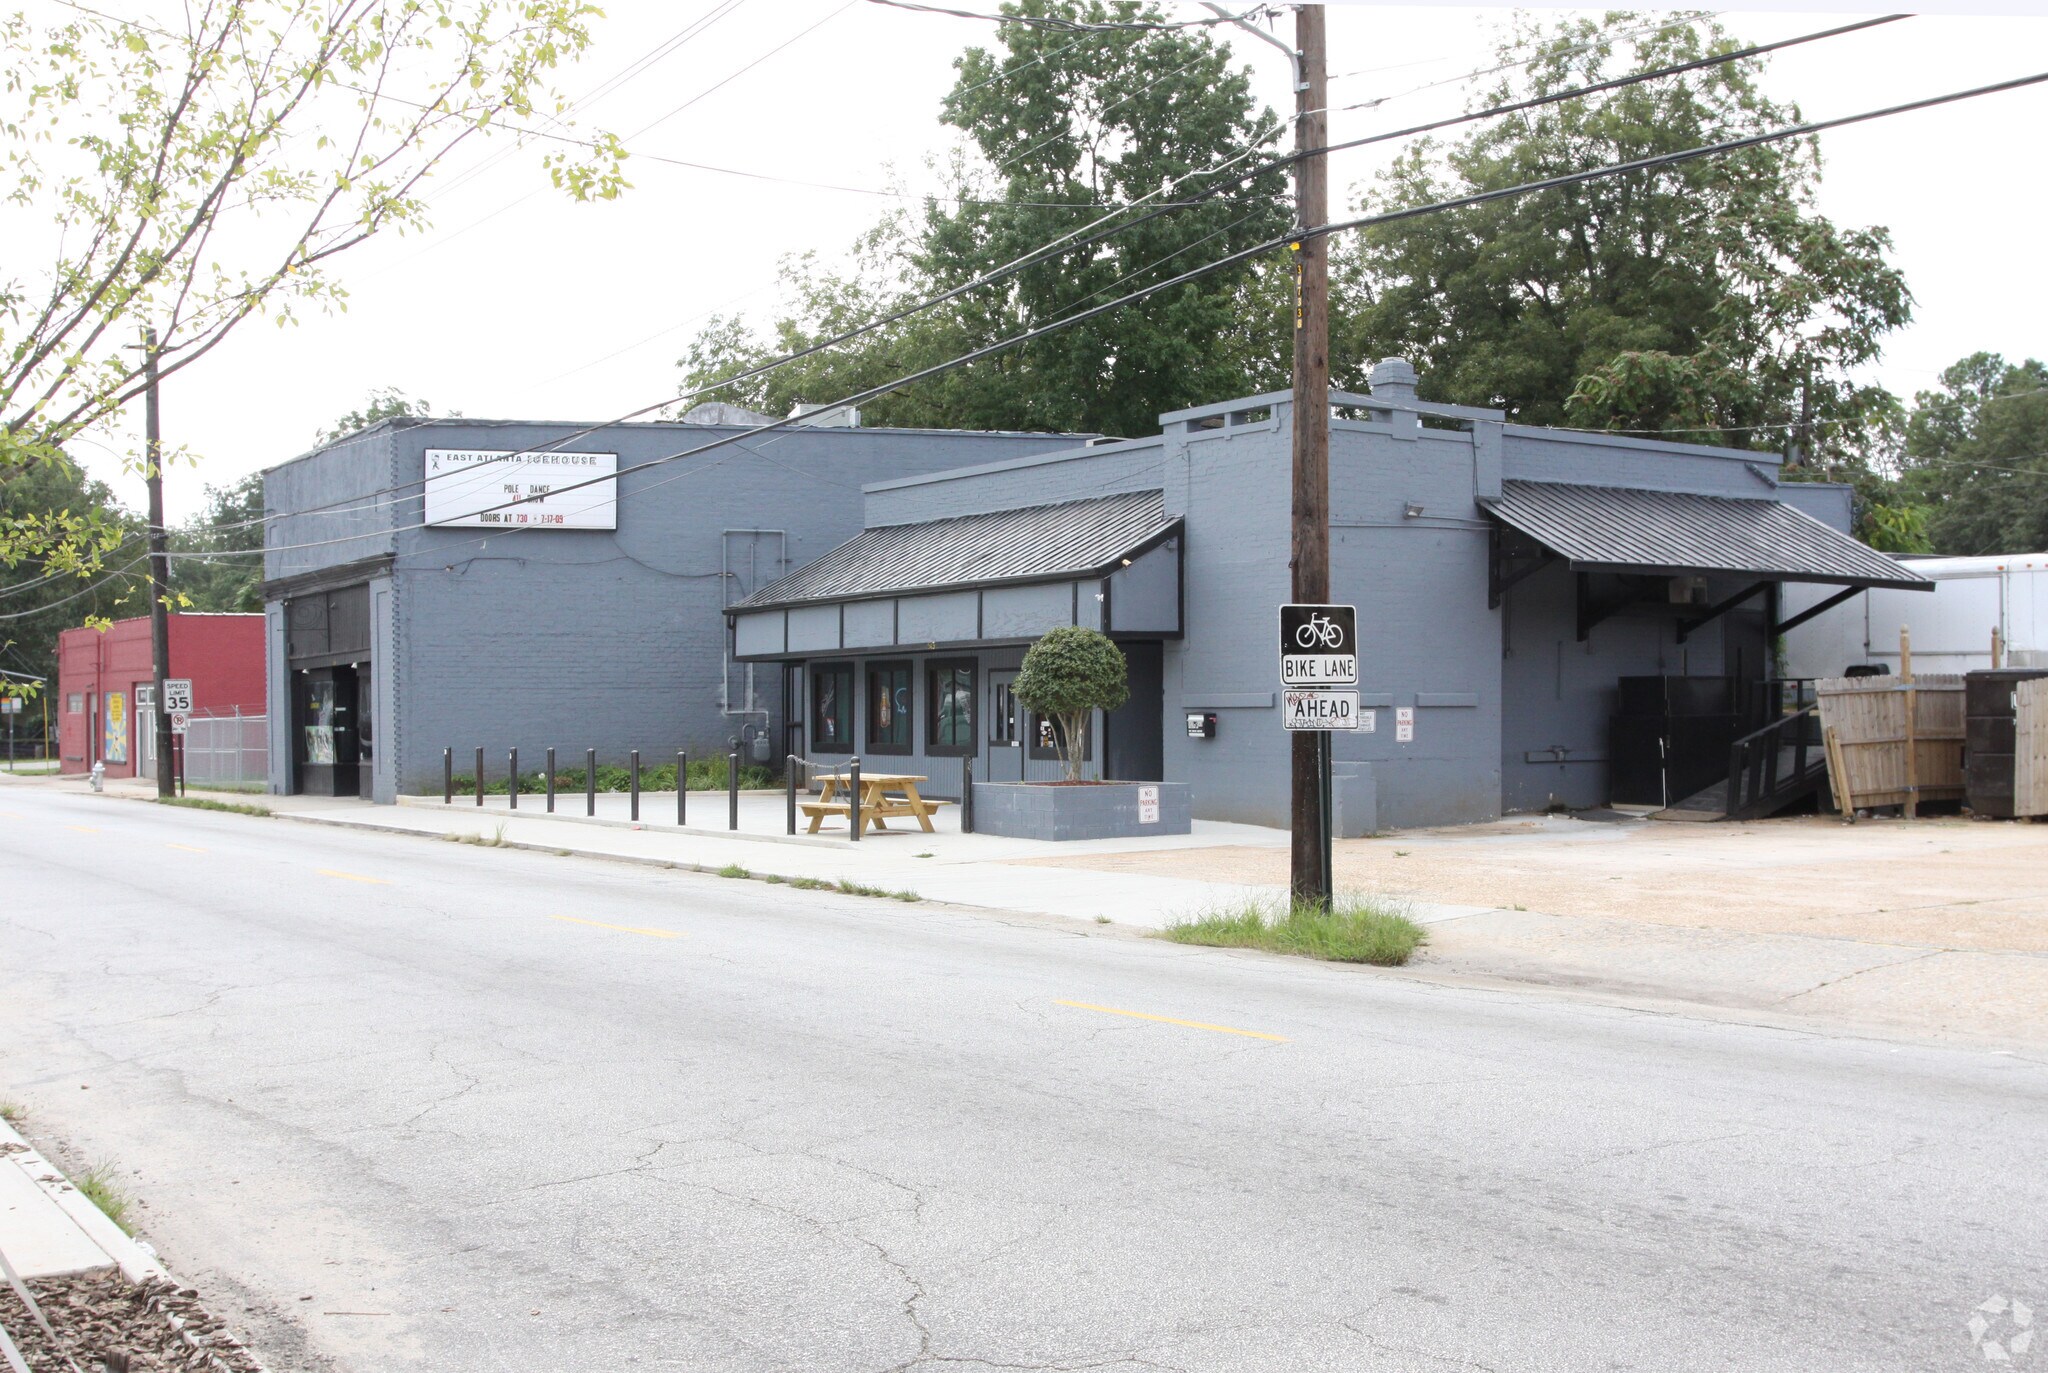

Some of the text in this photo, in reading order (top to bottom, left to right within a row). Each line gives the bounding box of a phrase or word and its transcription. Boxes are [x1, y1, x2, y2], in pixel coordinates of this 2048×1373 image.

[446, 454, 473, 462] EAST
[527, 455, 597, 466] ICEHOUSE
[503, 484, 519, 494] POLE
[480, 513, 500, 522] DOORS
[503, 514, 512, 522] AT
[516, 514, 528, 523] 730
[1285, 660, 1354, 677] BIKE LANE
[168, 697, 190, 709] 35
[1294, 700, 1350, 718] AHEAD
[1144, 790, 1153, 798] NO
